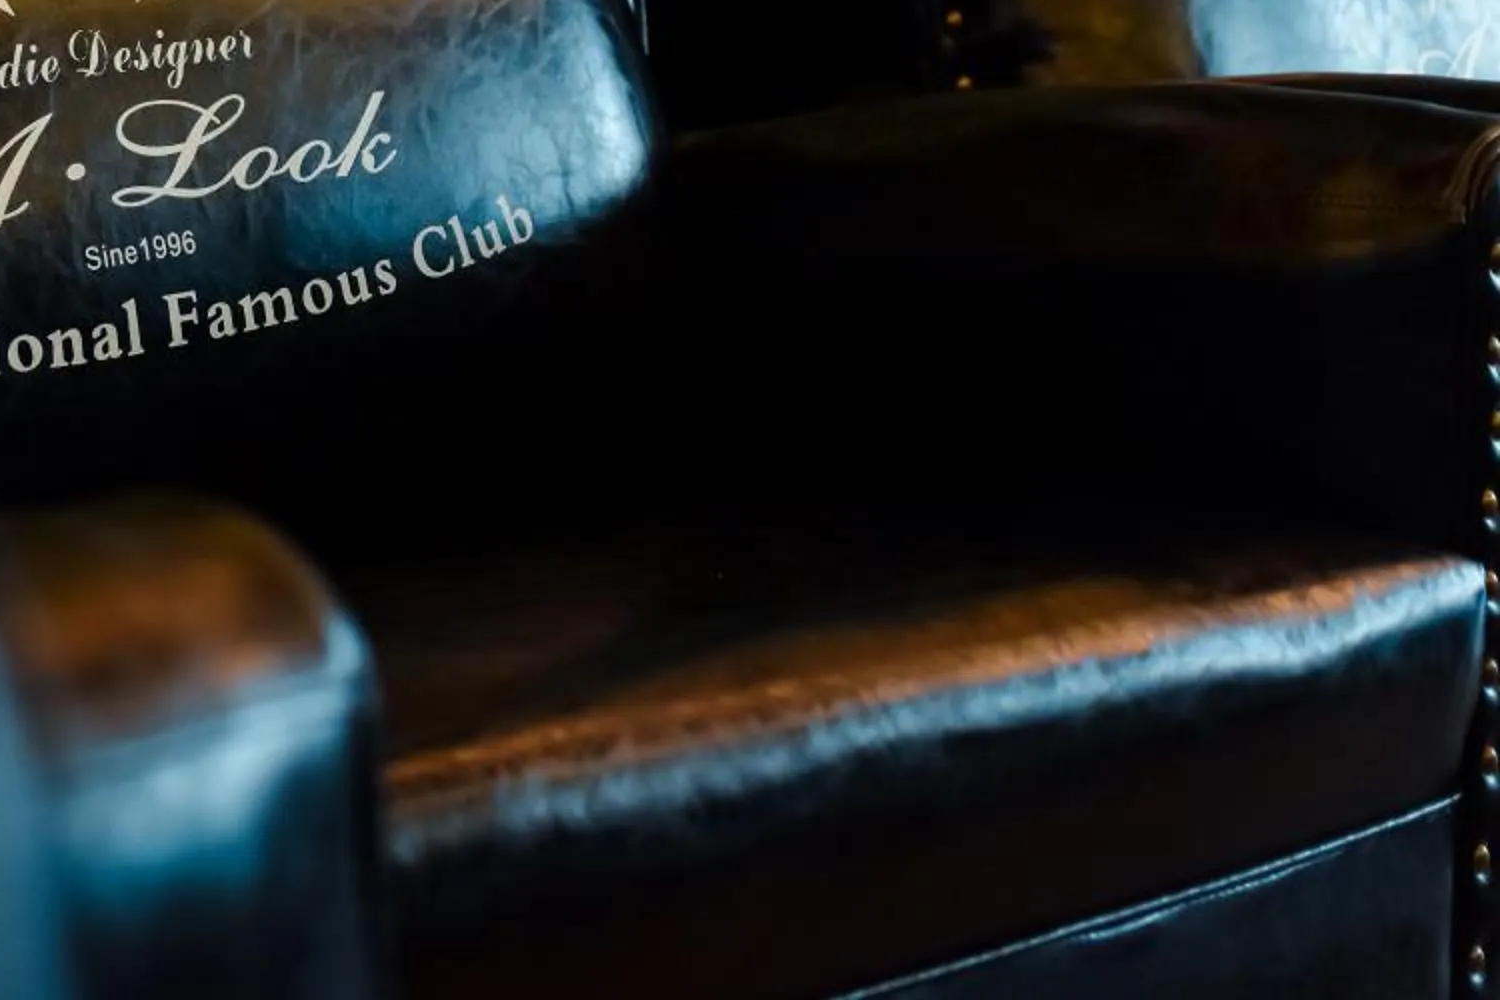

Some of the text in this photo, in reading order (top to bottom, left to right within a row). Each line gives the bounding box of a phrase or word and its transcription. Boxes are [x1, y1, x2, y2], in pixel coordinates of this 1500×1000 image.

[69, 26, 254, 90] Designer
[84, 229, 198, 271] Sine1996
[162, 258, 399, 349] Famous
[412, 195, 537, 280] Club
